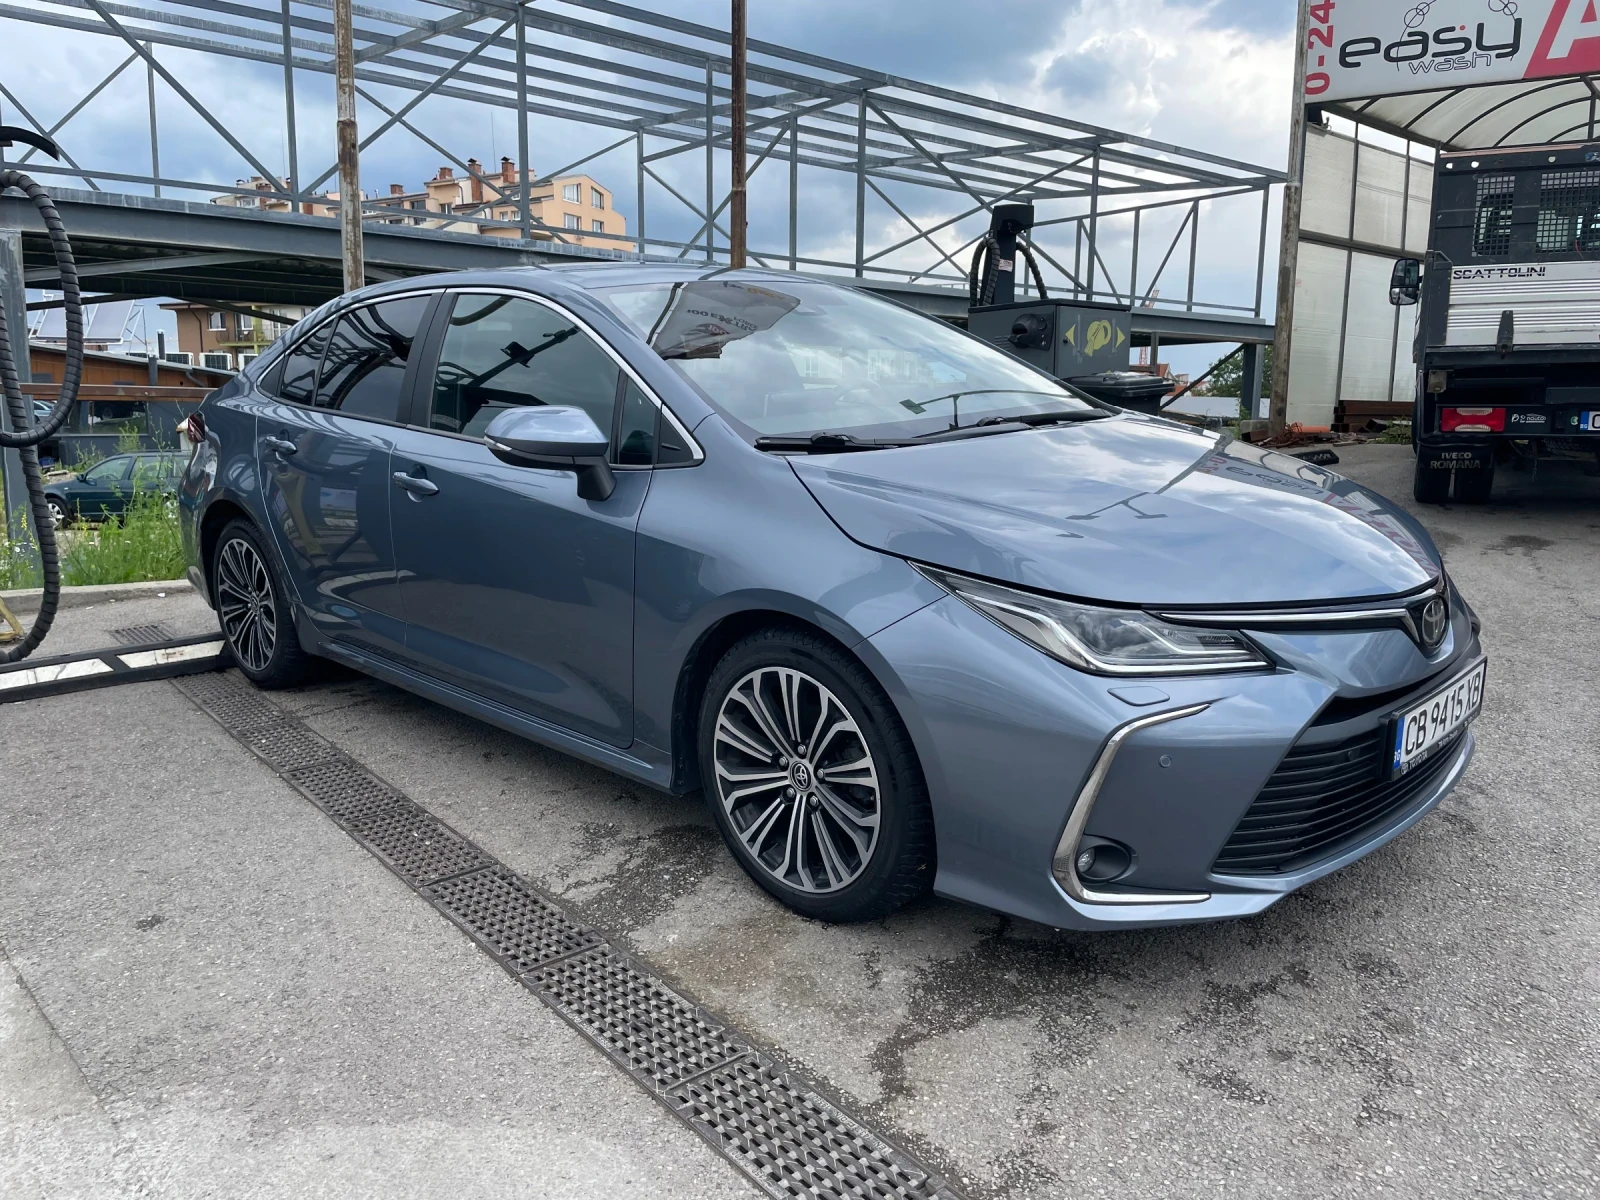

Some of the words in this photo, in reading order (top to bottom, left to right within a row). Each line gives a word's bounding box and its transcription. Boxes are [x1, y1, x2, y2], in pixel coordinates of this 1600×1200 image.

[1305, 0, 1335, 95] 0-24
[1339, 18, 1522, 68] easy
[1408, 52, 1492, 75] wash
[1453, 266, 1546, 280] SCATTOLINI
[1430, 460, 1481, 469] ROMANA
[1441, 452, 1472, 460] IVECO
[1405, 709, 1428, 756] CB
[1430, 683, 1465, 740] 9415
[1465, 671, 1481, 714] XB
[1409, 750, 1428, 770] TOYOTA
